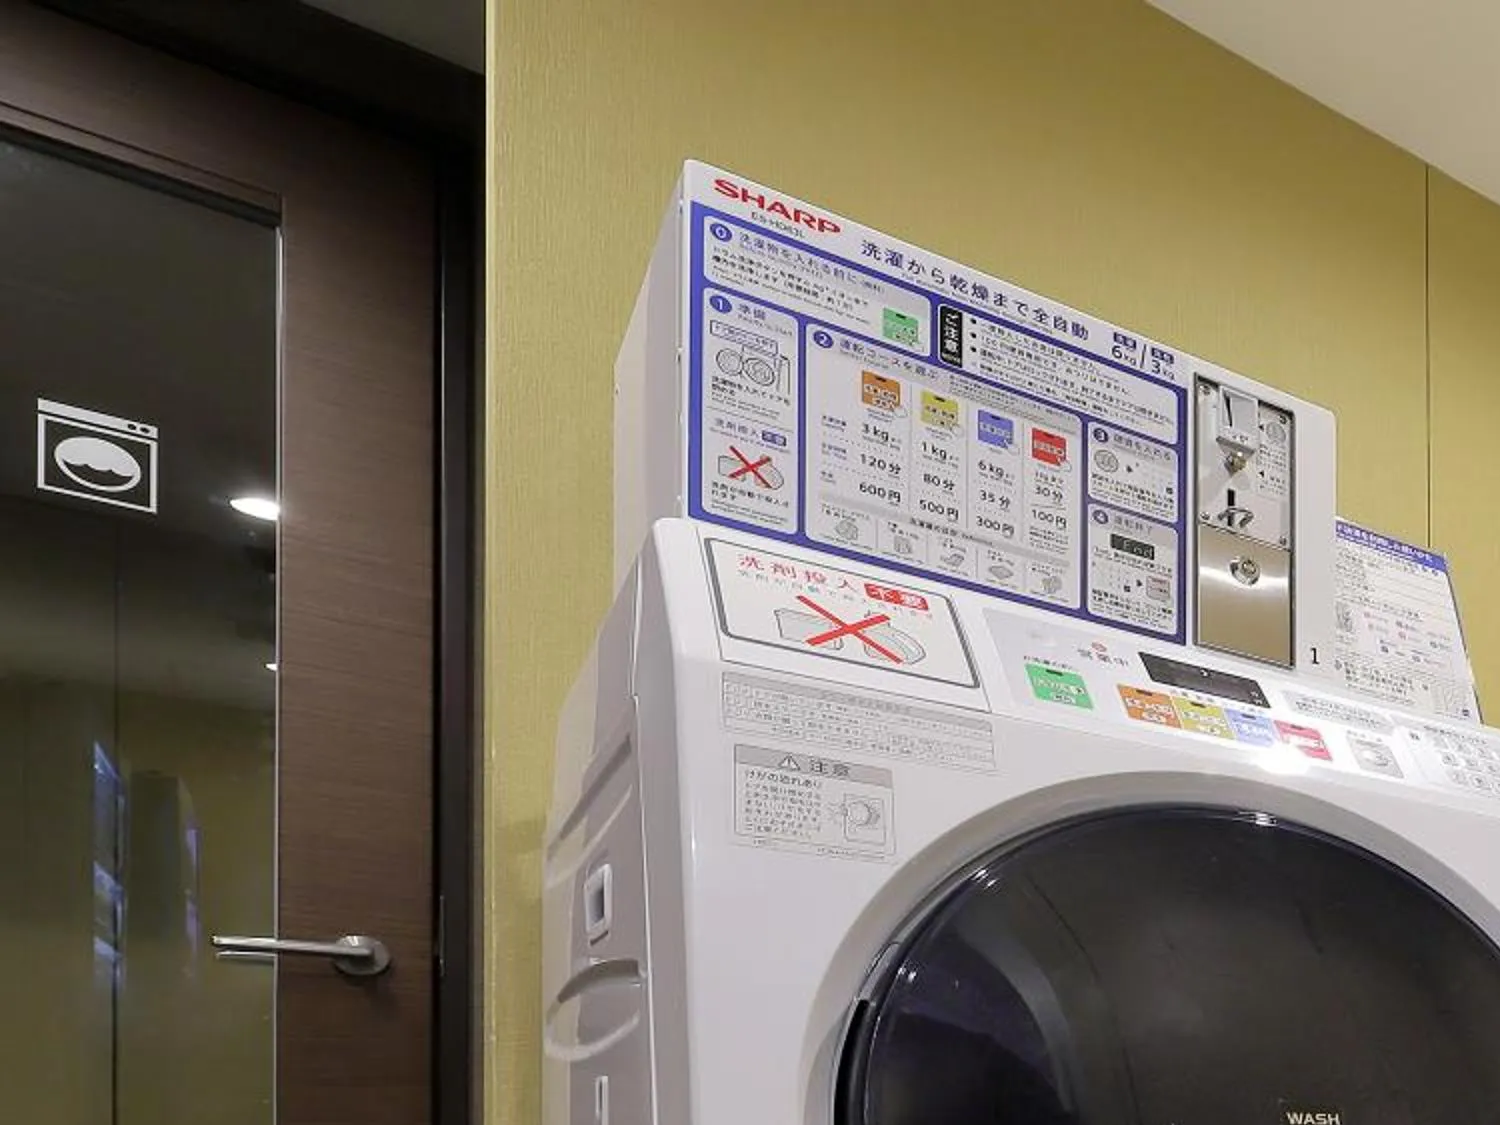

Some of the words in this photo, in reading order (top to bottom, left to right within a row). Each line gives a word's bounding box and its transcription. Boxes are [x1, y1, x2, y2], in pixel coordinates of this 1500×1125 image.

[714, 177, 841, 235] SHARP
[861, 240, 1089, 340] 洗濯から乾燥まで全自動
[1310, 647, 1319, 665] 1
